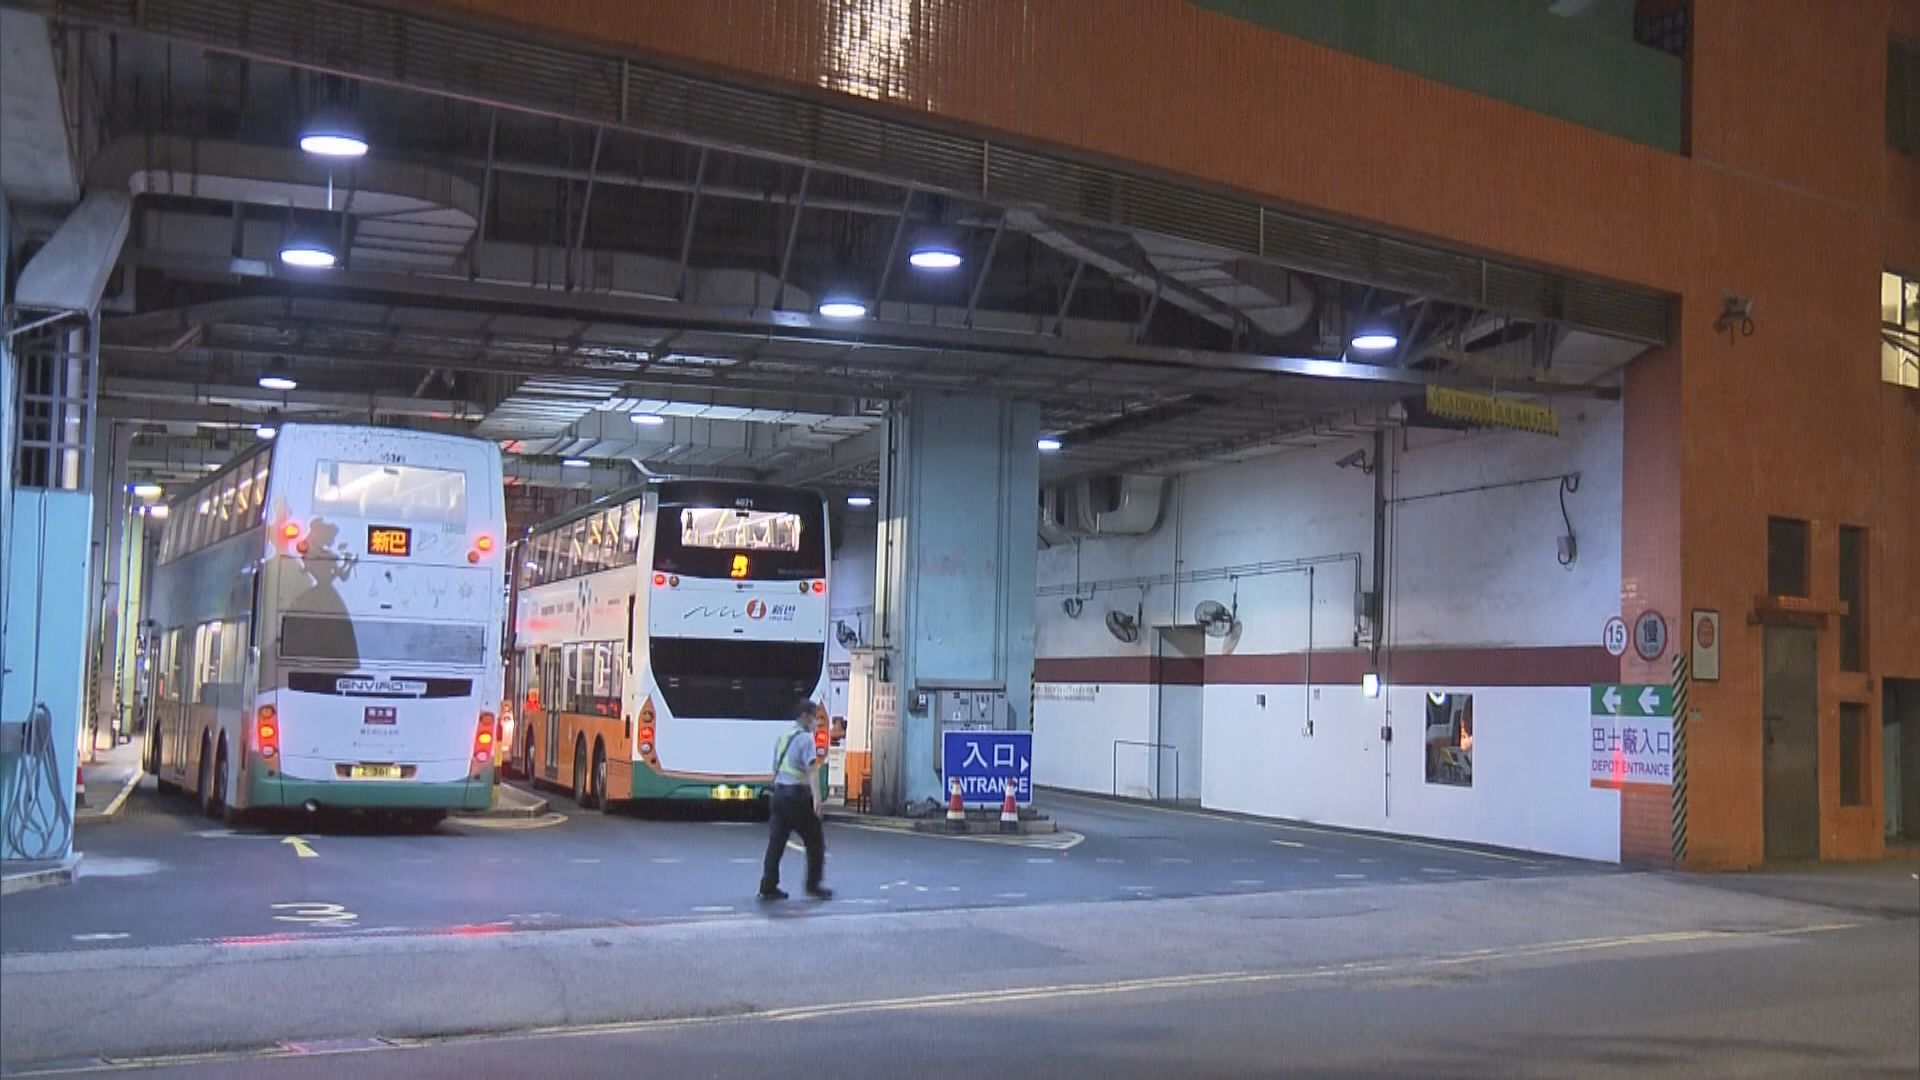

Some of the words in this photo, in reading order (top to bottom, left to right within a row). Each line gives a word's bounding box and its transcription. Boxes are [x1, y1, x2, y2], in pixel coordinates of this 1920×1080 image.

[371, 530, 407, 554] 新巴
[1607, 624, 1623, 643] 15
[339, 681, 404, 691] ENVIRO
[1592, 727, 1671, 756] 巴士廠入口
[962, 741, 1015, 768] 入口
[1592, 760, 1618, 772] DEPOT
[1622, 761, 1670, 776] ENTRANCE
